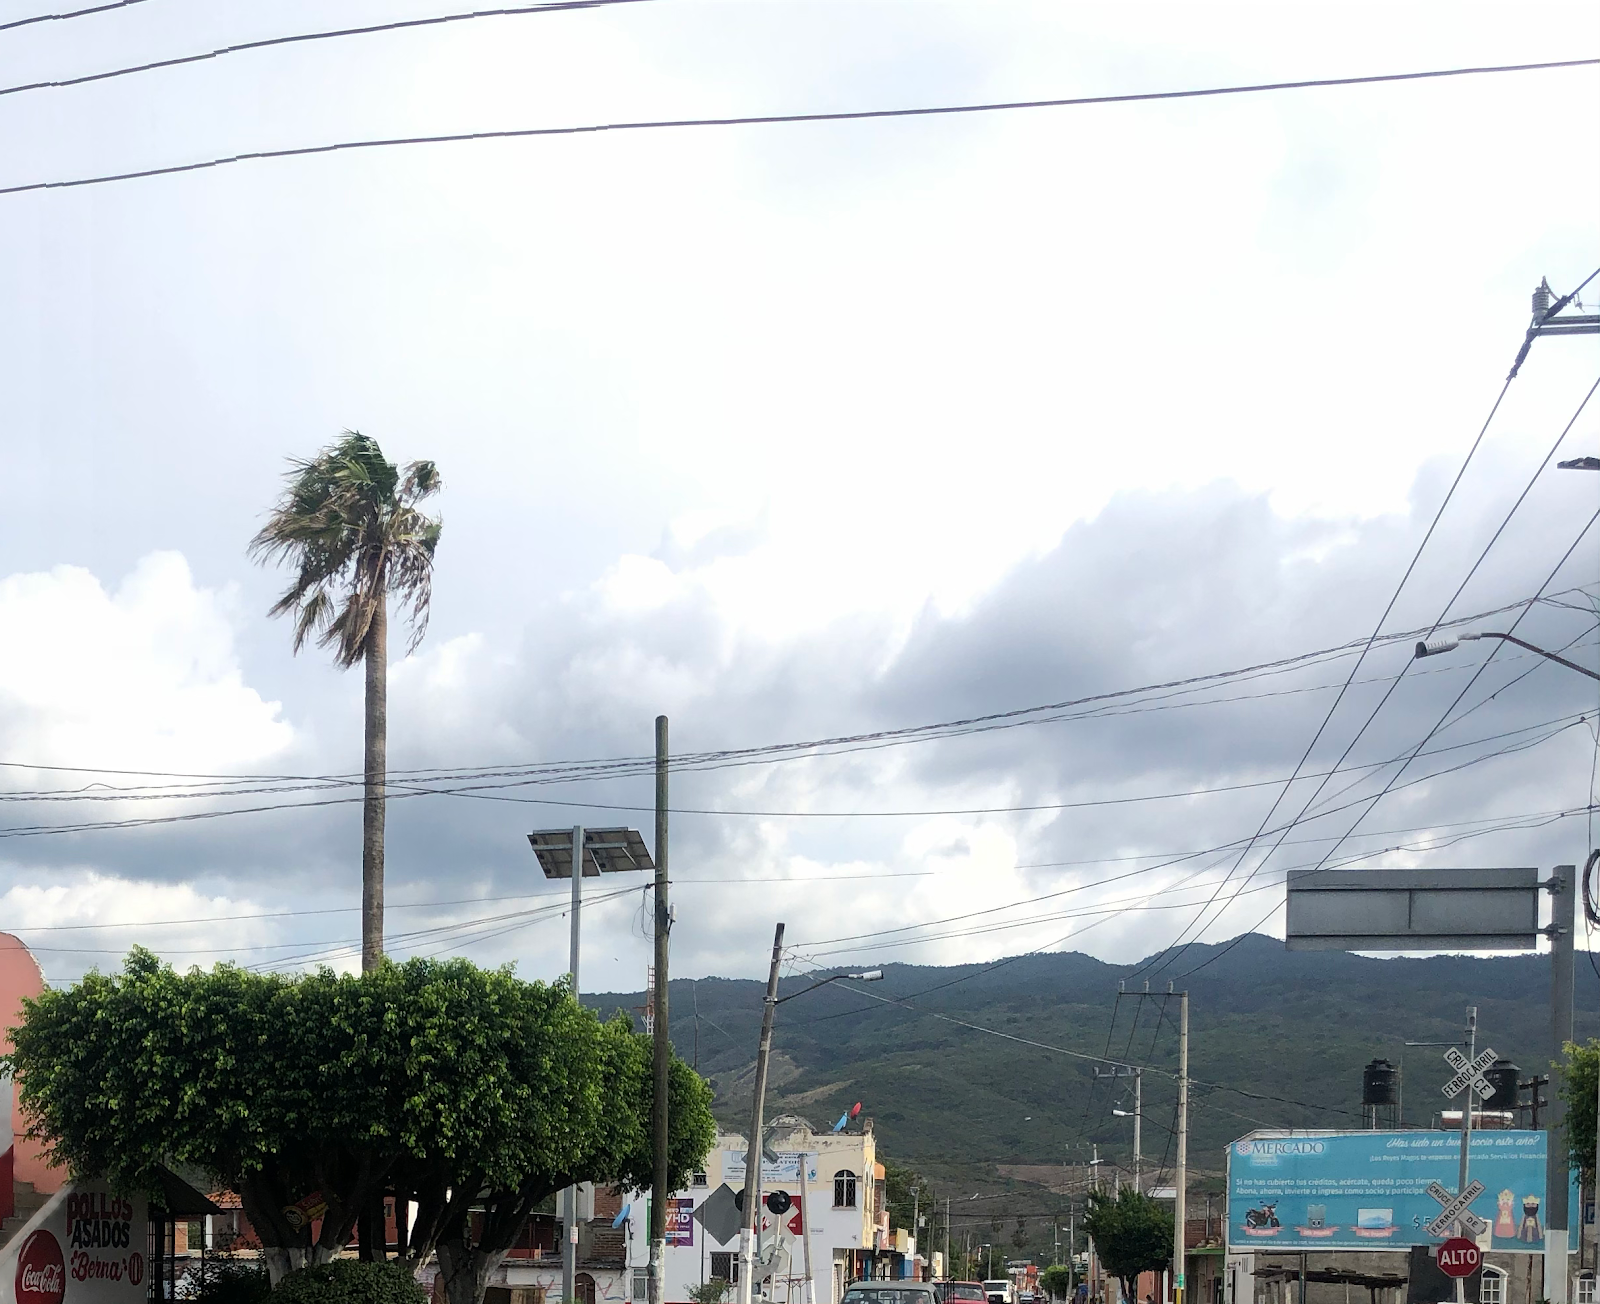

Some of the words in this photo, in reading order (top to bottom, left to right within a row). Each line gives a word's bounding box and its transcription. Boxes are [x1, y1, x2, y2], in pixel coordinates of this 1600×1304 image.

[1442, 1052, 1497, 1099] FERROCARRIL
[1252, 1141, 1325, 1154] MERCADO
[1411, 1137, 1430, 1147] sido
[1431, 1138, 1444, 1147] un
[1495, 1137, 1514, 1146] este
[1516, 1135, 1541, 1146] año?
[1254, 1178, 1266, 1186] has
[1267, 1178, 1295, 1186] cubierto
[1371, 1178, 1394, 1187] queda
[1395, 1179, 1413, 1187] poco
[1366, 1187, 1385, 1195] socio
[66, 1192, 134, 1238] POLLOS
[1429, 1184, 1452, 1206] CRUCE
[1465, 1216, 1479, 1229] DE
[1430, 1184, 1481, 1234] FERROCARRIL
[70, 1219, 131, 1250] ASADOS
[1439, 1248, 1478, 1265] ALTO
[21, 1263, 63, 1293] Coca-Cola
